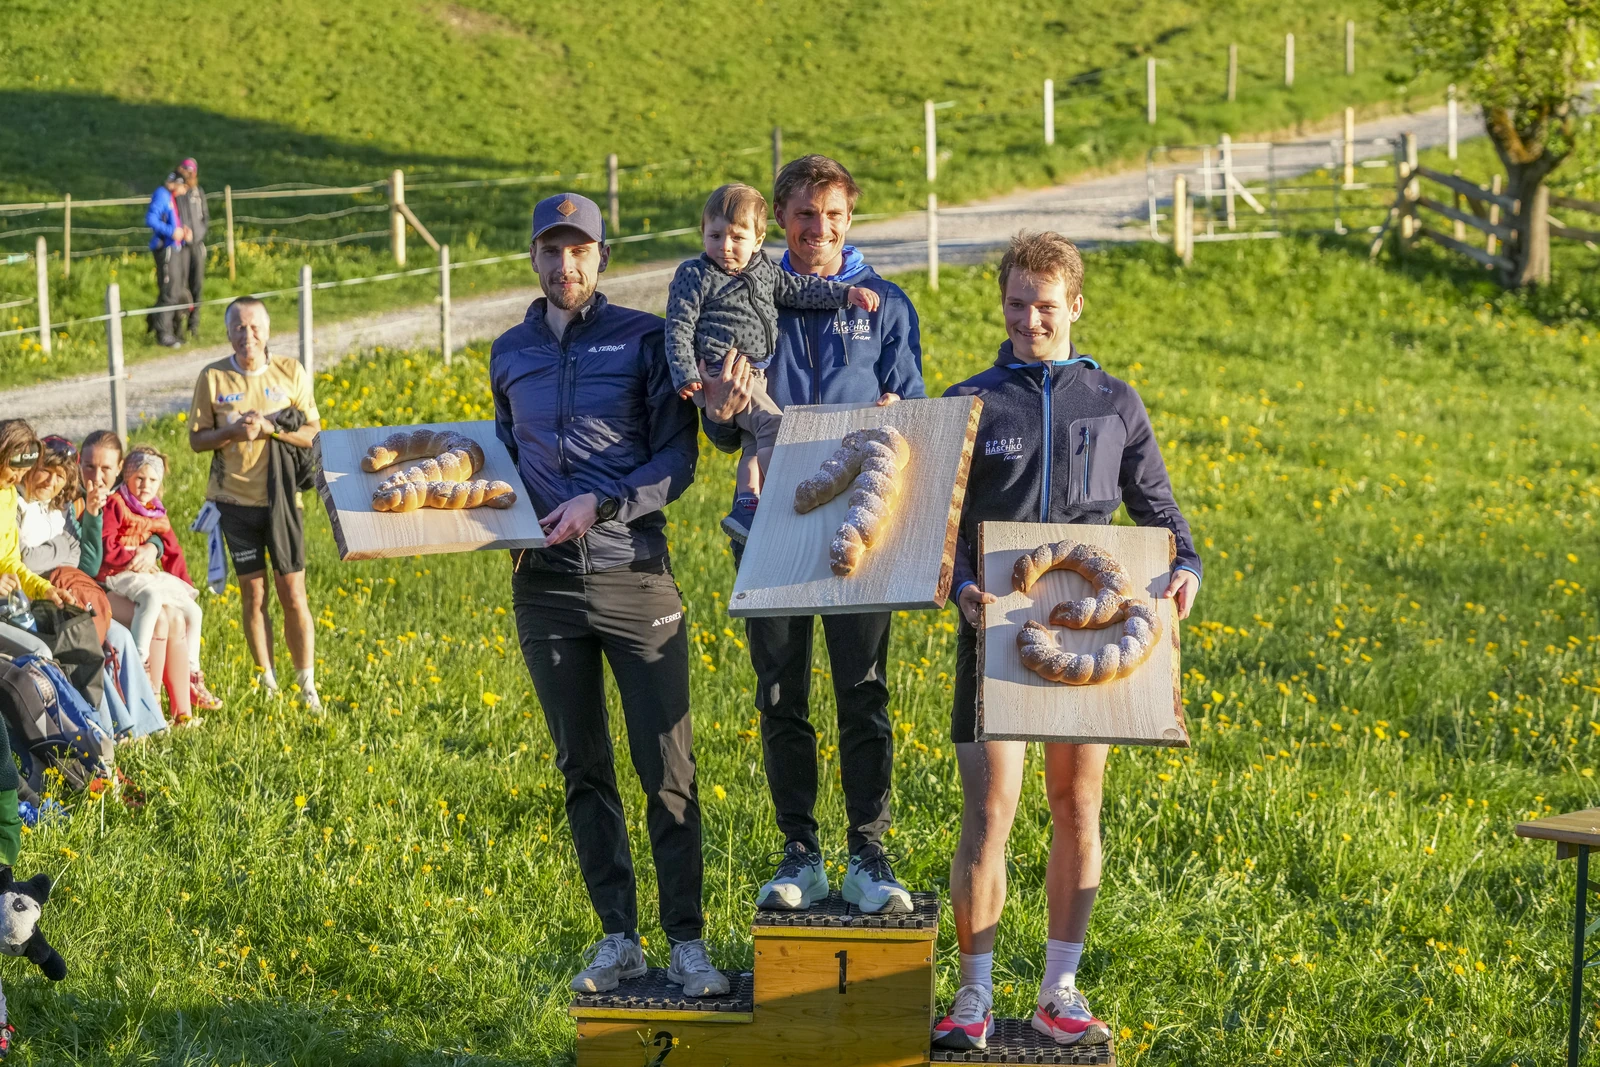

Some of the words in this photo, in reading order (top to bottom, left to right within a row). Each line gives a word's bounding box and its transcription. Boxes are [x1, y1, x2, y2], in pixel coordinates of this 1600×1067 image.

[833, 318, 871, 328] SPORT
[832, 325, 871, 333] HASCHKO
[851, 332, 871, 341] Team
[985, 437, 1023, 448] SPORT
[985, 443, 1022, 455] HASCHKO
[1003, 452, 1024, 462] Team
[1011, 539, 1163, 685] 3
[834, 950, 847, 994] 1
[653, 1031, 674, 1067] 2
